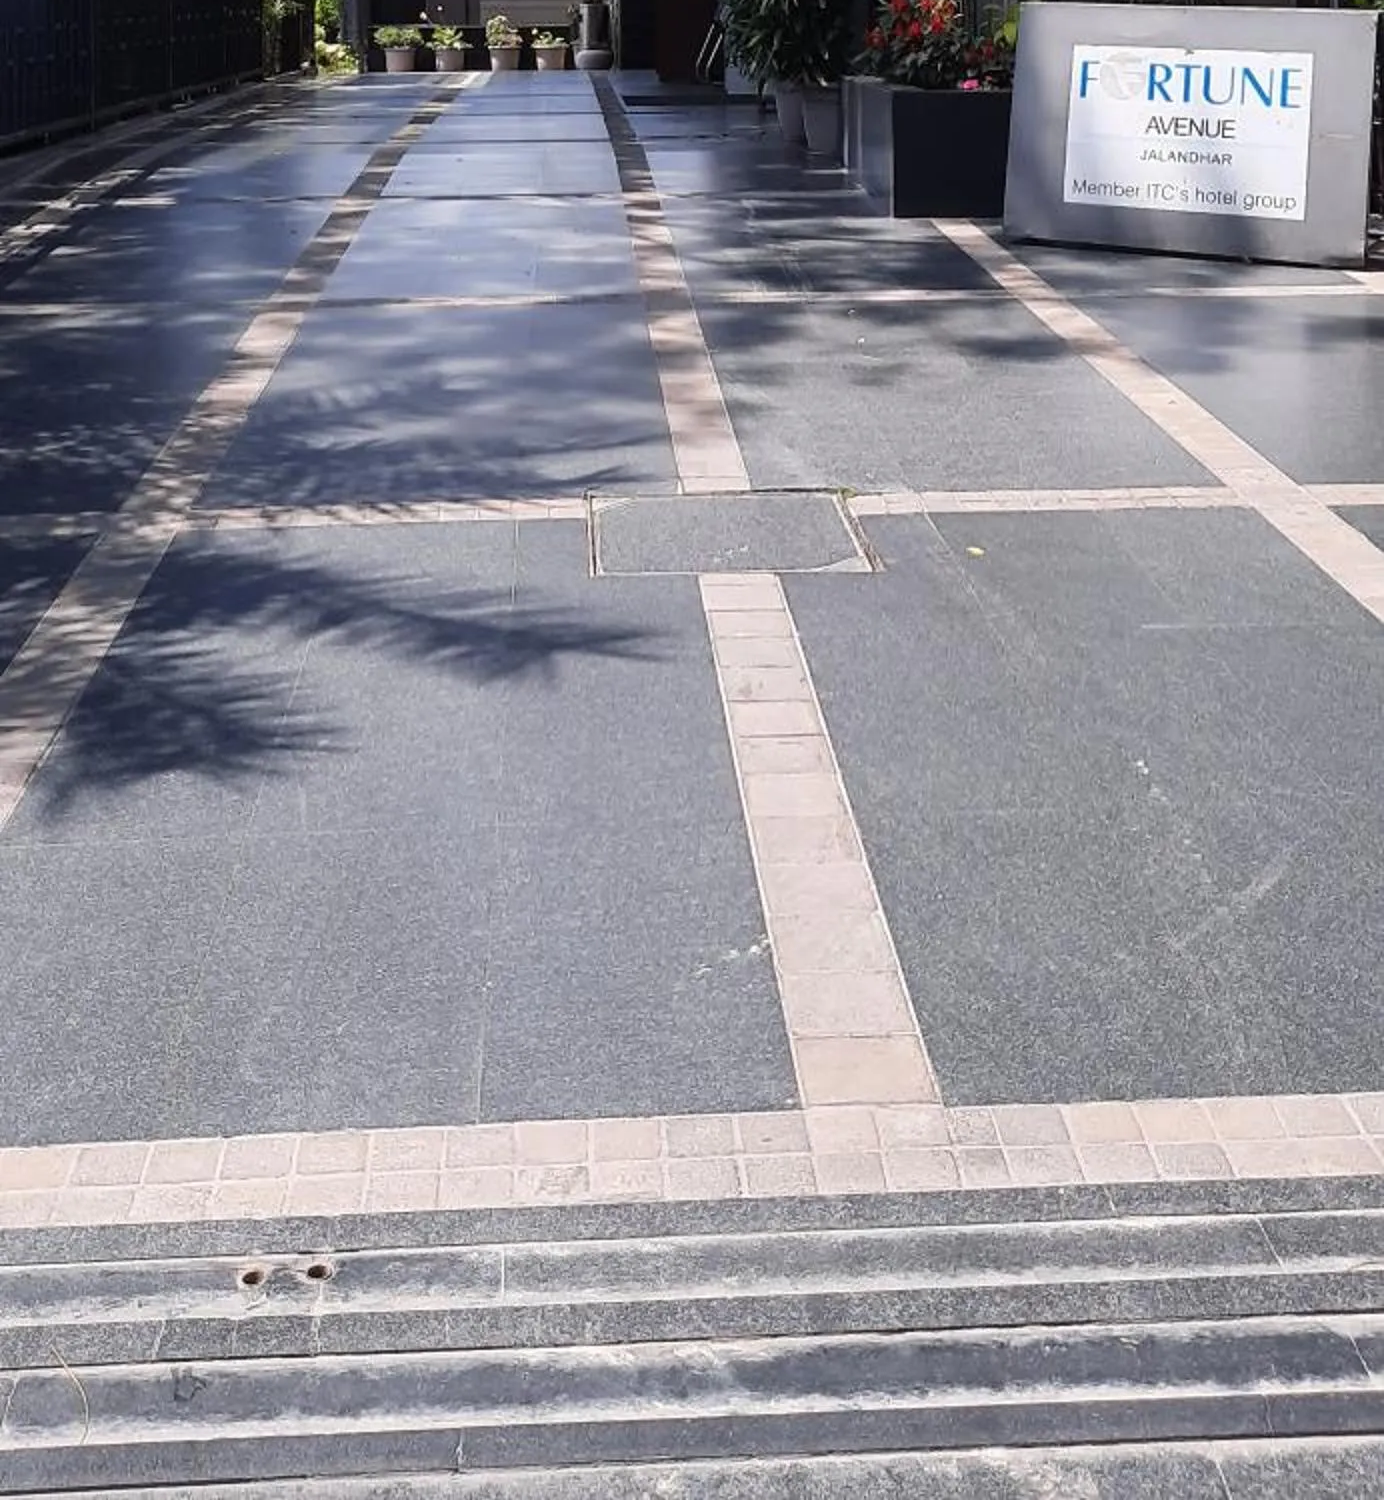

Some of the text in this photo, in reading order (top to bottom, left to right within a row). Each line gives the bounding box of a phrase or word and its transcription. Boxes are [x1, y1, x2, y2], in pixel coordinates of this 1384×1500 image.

[1144, 115, 1236, 139] AVENUE
[1139, 149, 1233, 166] JALANDHAR
[1072, 179, 1298, 212] Member ITC's hotel group
